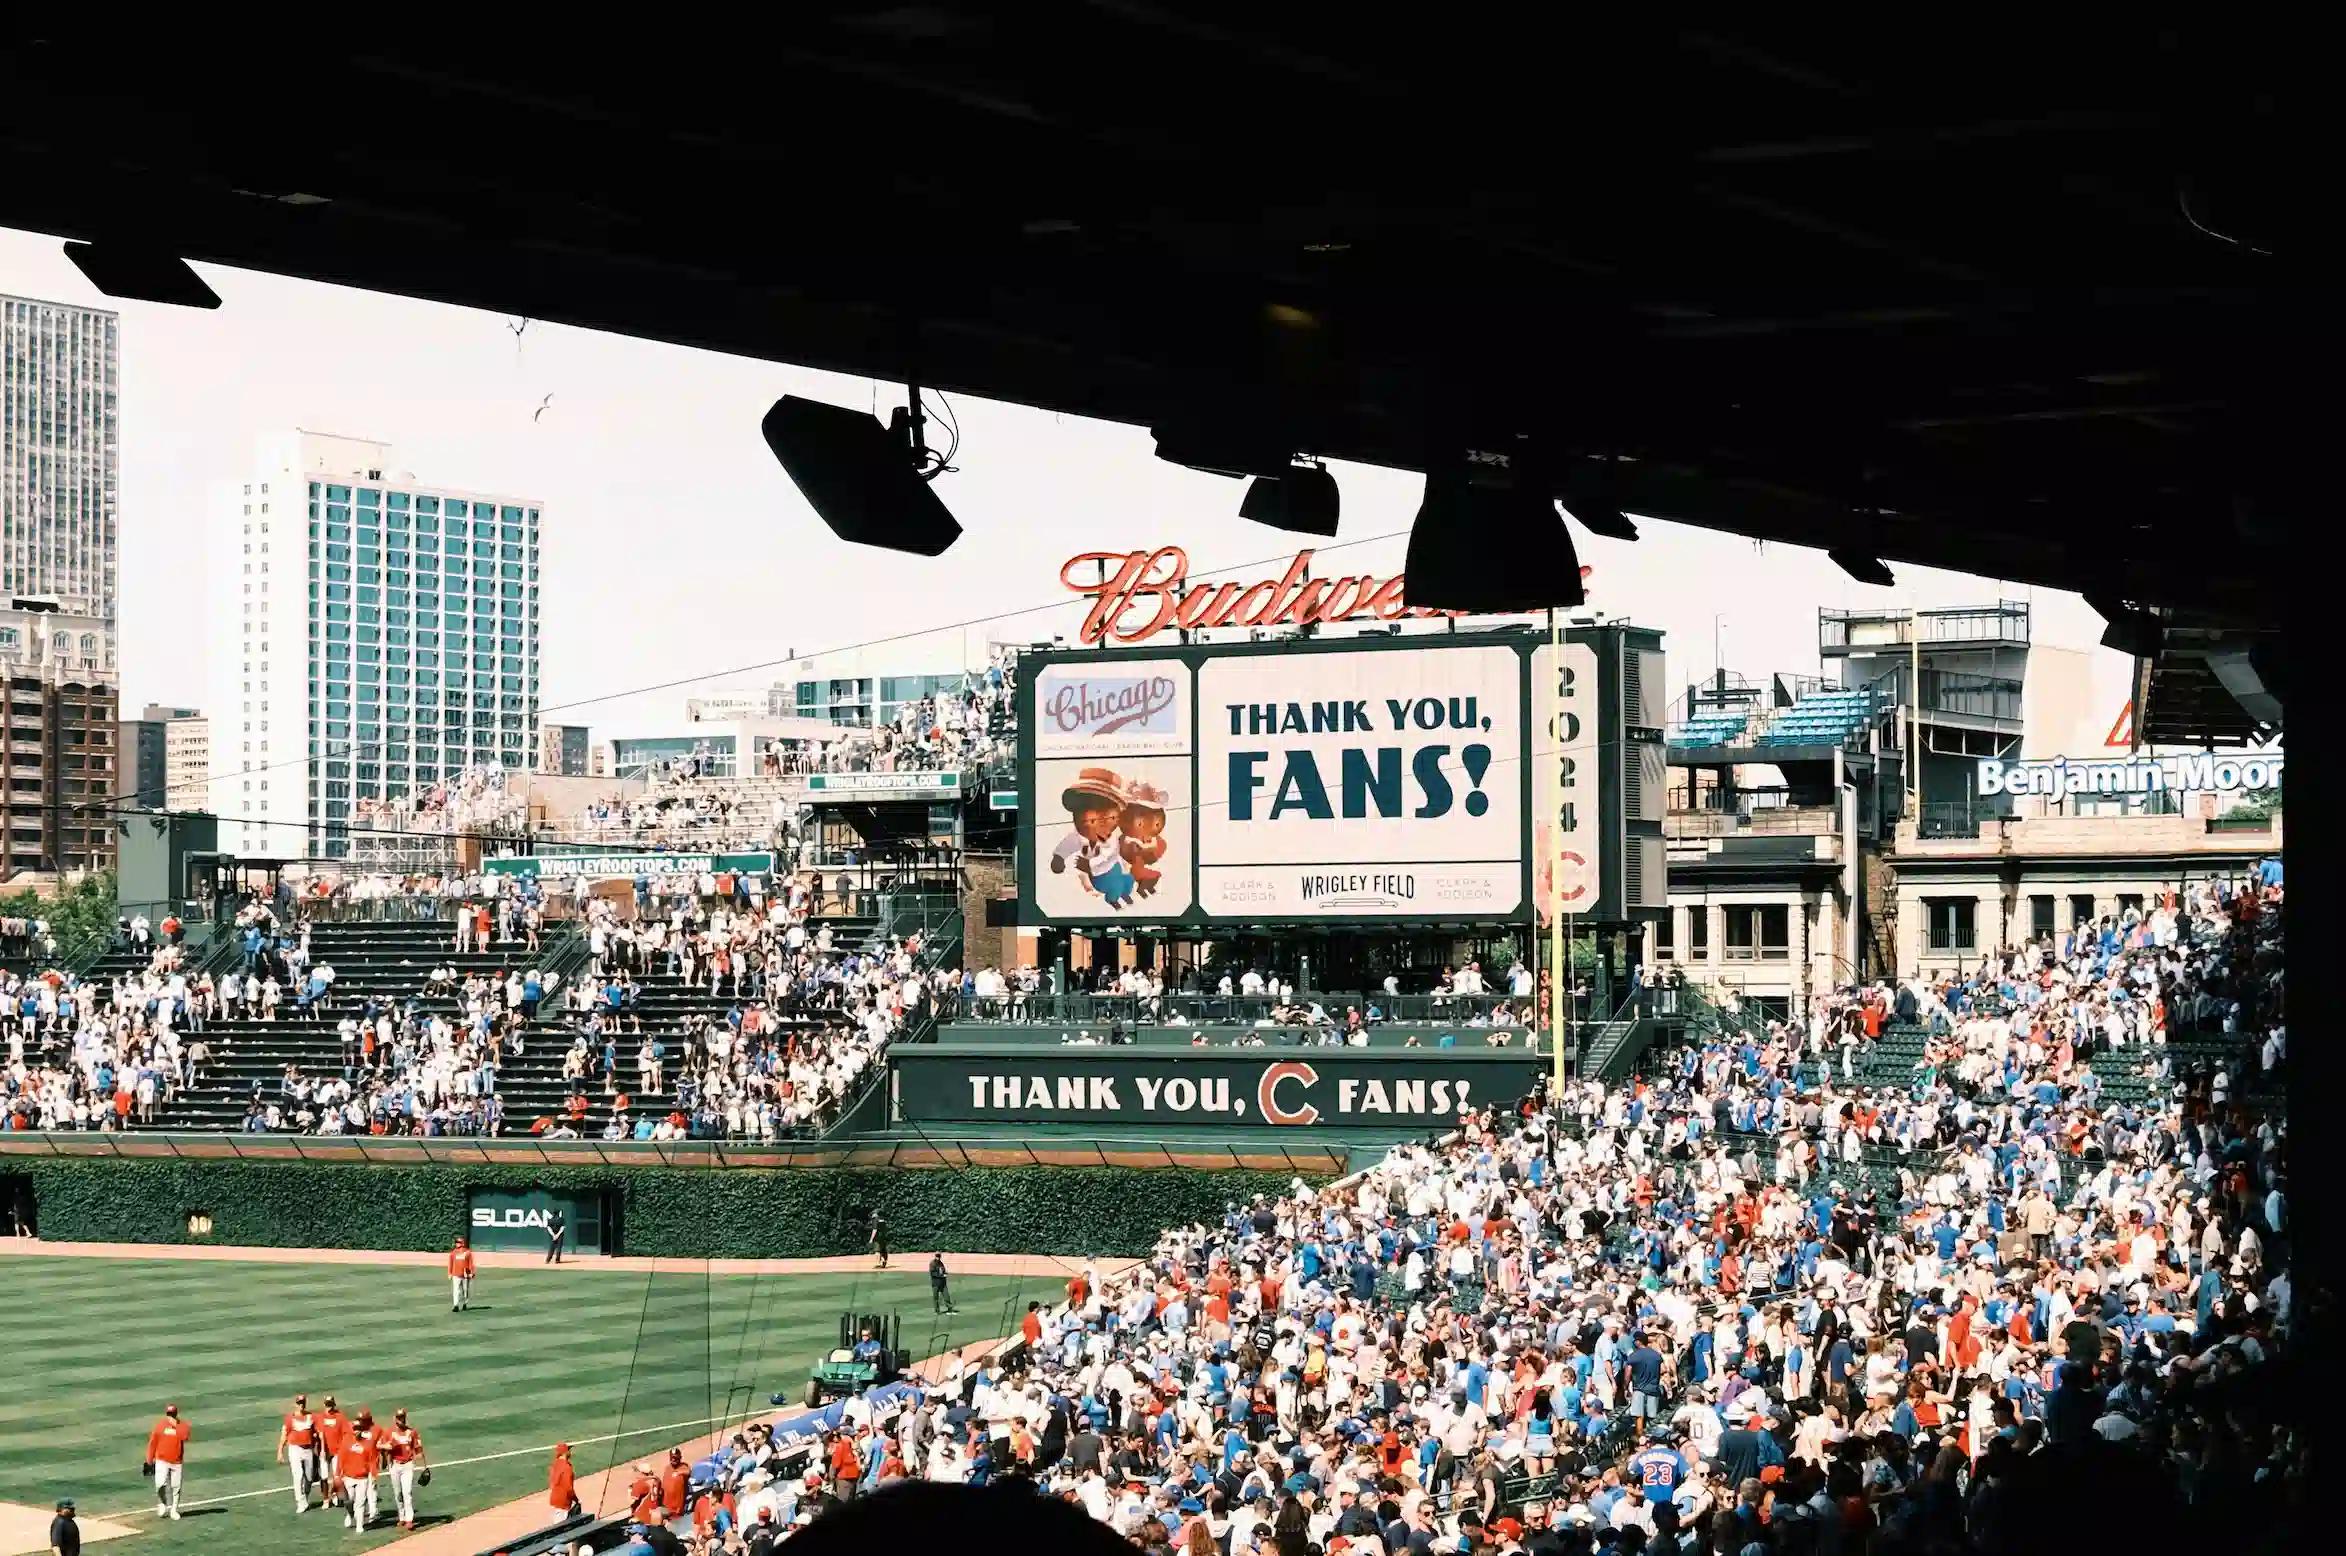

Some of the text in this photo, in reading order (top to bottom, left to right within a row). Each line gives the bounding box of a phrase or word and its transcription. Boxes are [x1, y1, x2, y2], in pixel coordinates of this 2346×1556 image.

[1060, 545, 1592, 644] Budwe
[1045, 676, 1175, 738] Chicago
[1226, 697, 1491, 736] THANK YOU,
[1549, 667, 1581, 832] 2024
[1228, 744, 1492, 821] FANS!
[1977, 754, 2163, 804] Benjamin
[538, 857, 712, 875] WRIGLEYROOFTOPS.COM
[1301, 874, 1415, 900] WRIGLEY FIELD
[968, 1062, 1471, 1125] THANK YOU, C FANS!
[1643, 1463, 1673, 1486] 23
